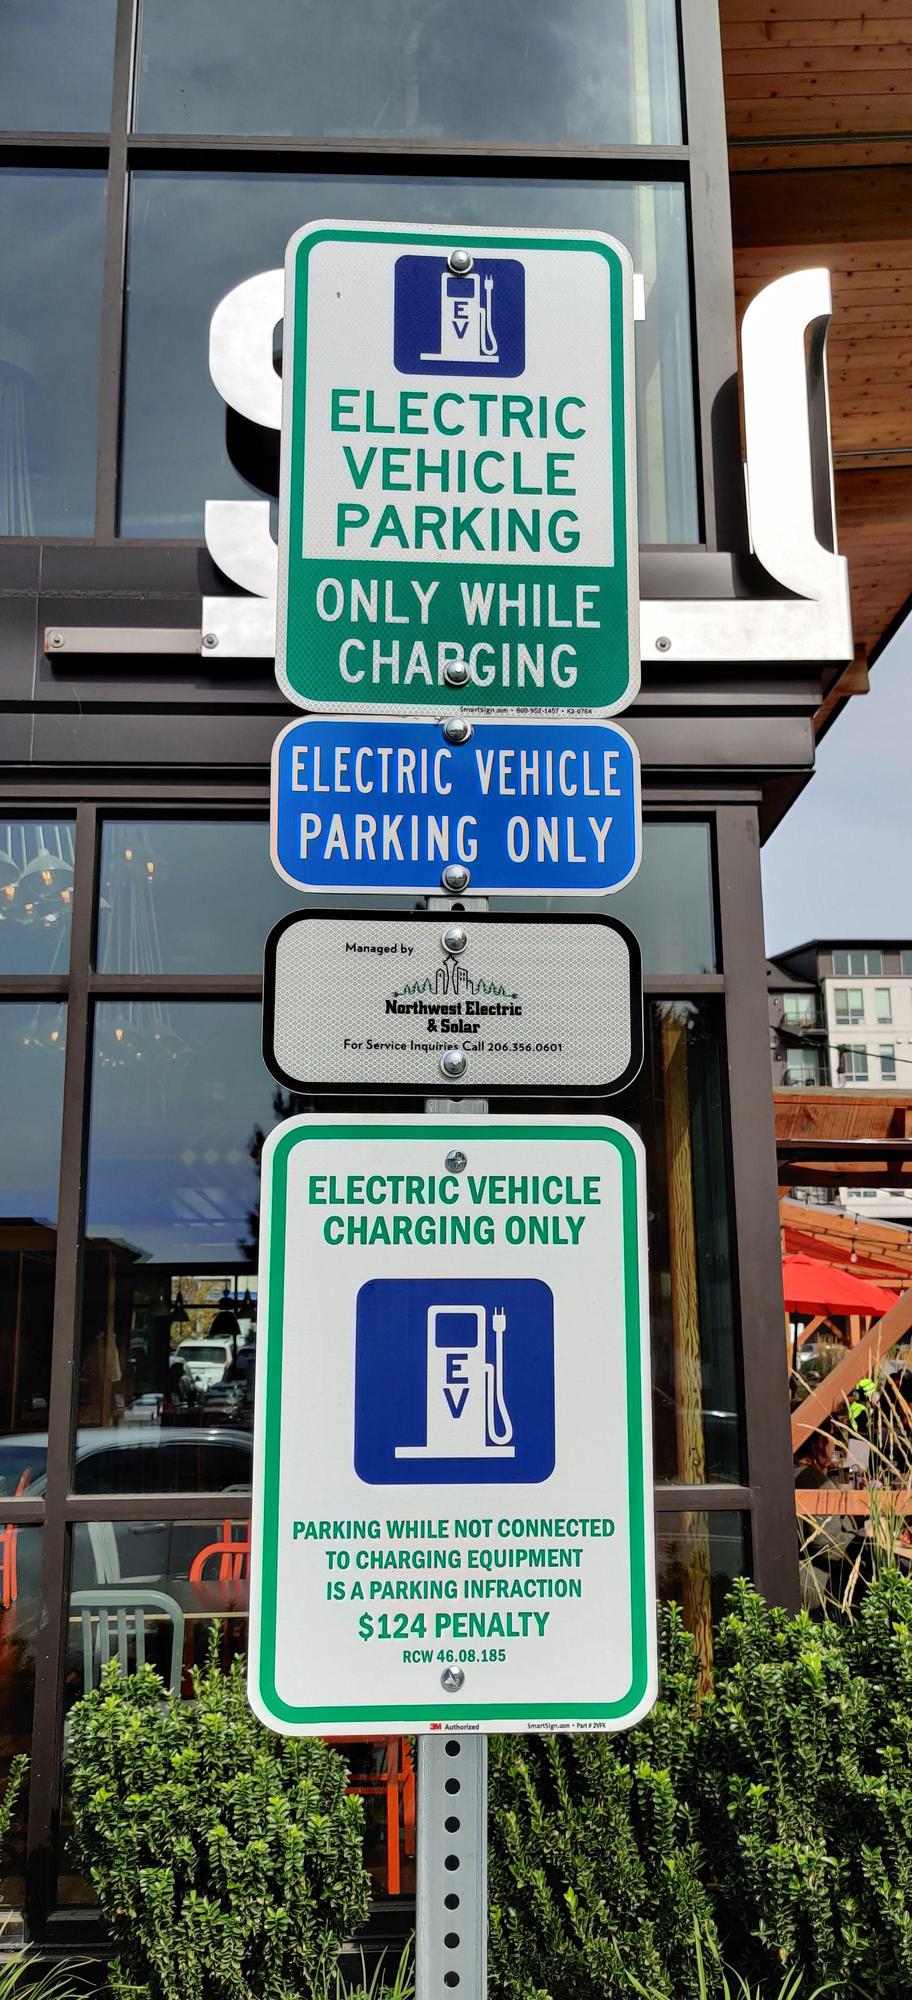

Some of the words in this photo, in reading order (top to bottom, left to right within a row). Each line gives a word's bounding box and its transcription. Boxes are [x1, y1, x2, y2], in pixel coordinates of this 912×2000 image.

[451, 300, 470, 339] EV
[331, 388, 586, 440] ELECTRIC
[342, 446, 577, 496] VEHICLE
[336, 503, 581, 554] PARKING
[316, 577, 440, 625] ONLY
[460, 582, 601, 629] WHILE
[338, 638, 578, 689] CHARGING
[291, 746, 453, 795] ELECTRIC
[475, 749, 622, 797] VEHICLE
[299, 812, 478, 863] PARKING
[506, 816, 614, 863] ONLY
[345, 942, 398, 956] Managed
[400, 943, 414, 956] by
[385, 1000, 462, 1015] Northwest
[465, 1001, 522, 1016] Electric
[427, 1019, 438, 1033] &
[440, 1019, 481, 1034] Solar
[343, 1039, 363, 1050] For
[366, 1040, 407, 1051] Service
[410, 1040, 459, 1053] Inquiries
[462, 1041, 485, 1052] Call
[488, 1042, 563, 1053] 206.356.0601
[308, 1175, 460, 1205] ELECTRIC
[467, 1175, 601, 1205] VEHICLE
[323, 1215, 495, 1246] CHARGING
[505, 1215, 586, 1246] ONLY
[443, 1353, 470, 1419] EV
[292, 1520, 381, 1540] PARKING
[386, 1519, 449, 1539] WHILE
[454, 1518, 493, 1539] NOT
[497, 1518, 615, 1538] CONNECTED
[326, 1550, 351, 1570] TO
[356, 1550, 462, 1570] CHARGING
[467, 1548, 583, 1571] EQUIPMENT
[326, 1581, 346, 1601] IS
[350, 1581, 364, 1600] A
[369, 1580, 458, 1600] PARKING
[464, 1578, 582, 1599] INFRACTION
[358, 1612, 427, 1641] $124
[435, 1612, 550, 1638] PENALTY
[403, 1649, 434, 1663] RCW
[437, 1649, 506, 1663] 46.08.185
[430, 1723, 442, 1731] 3M
[444, 1723, 480, 1731] Authorized
[576, 1722, 588, 1730] Part
